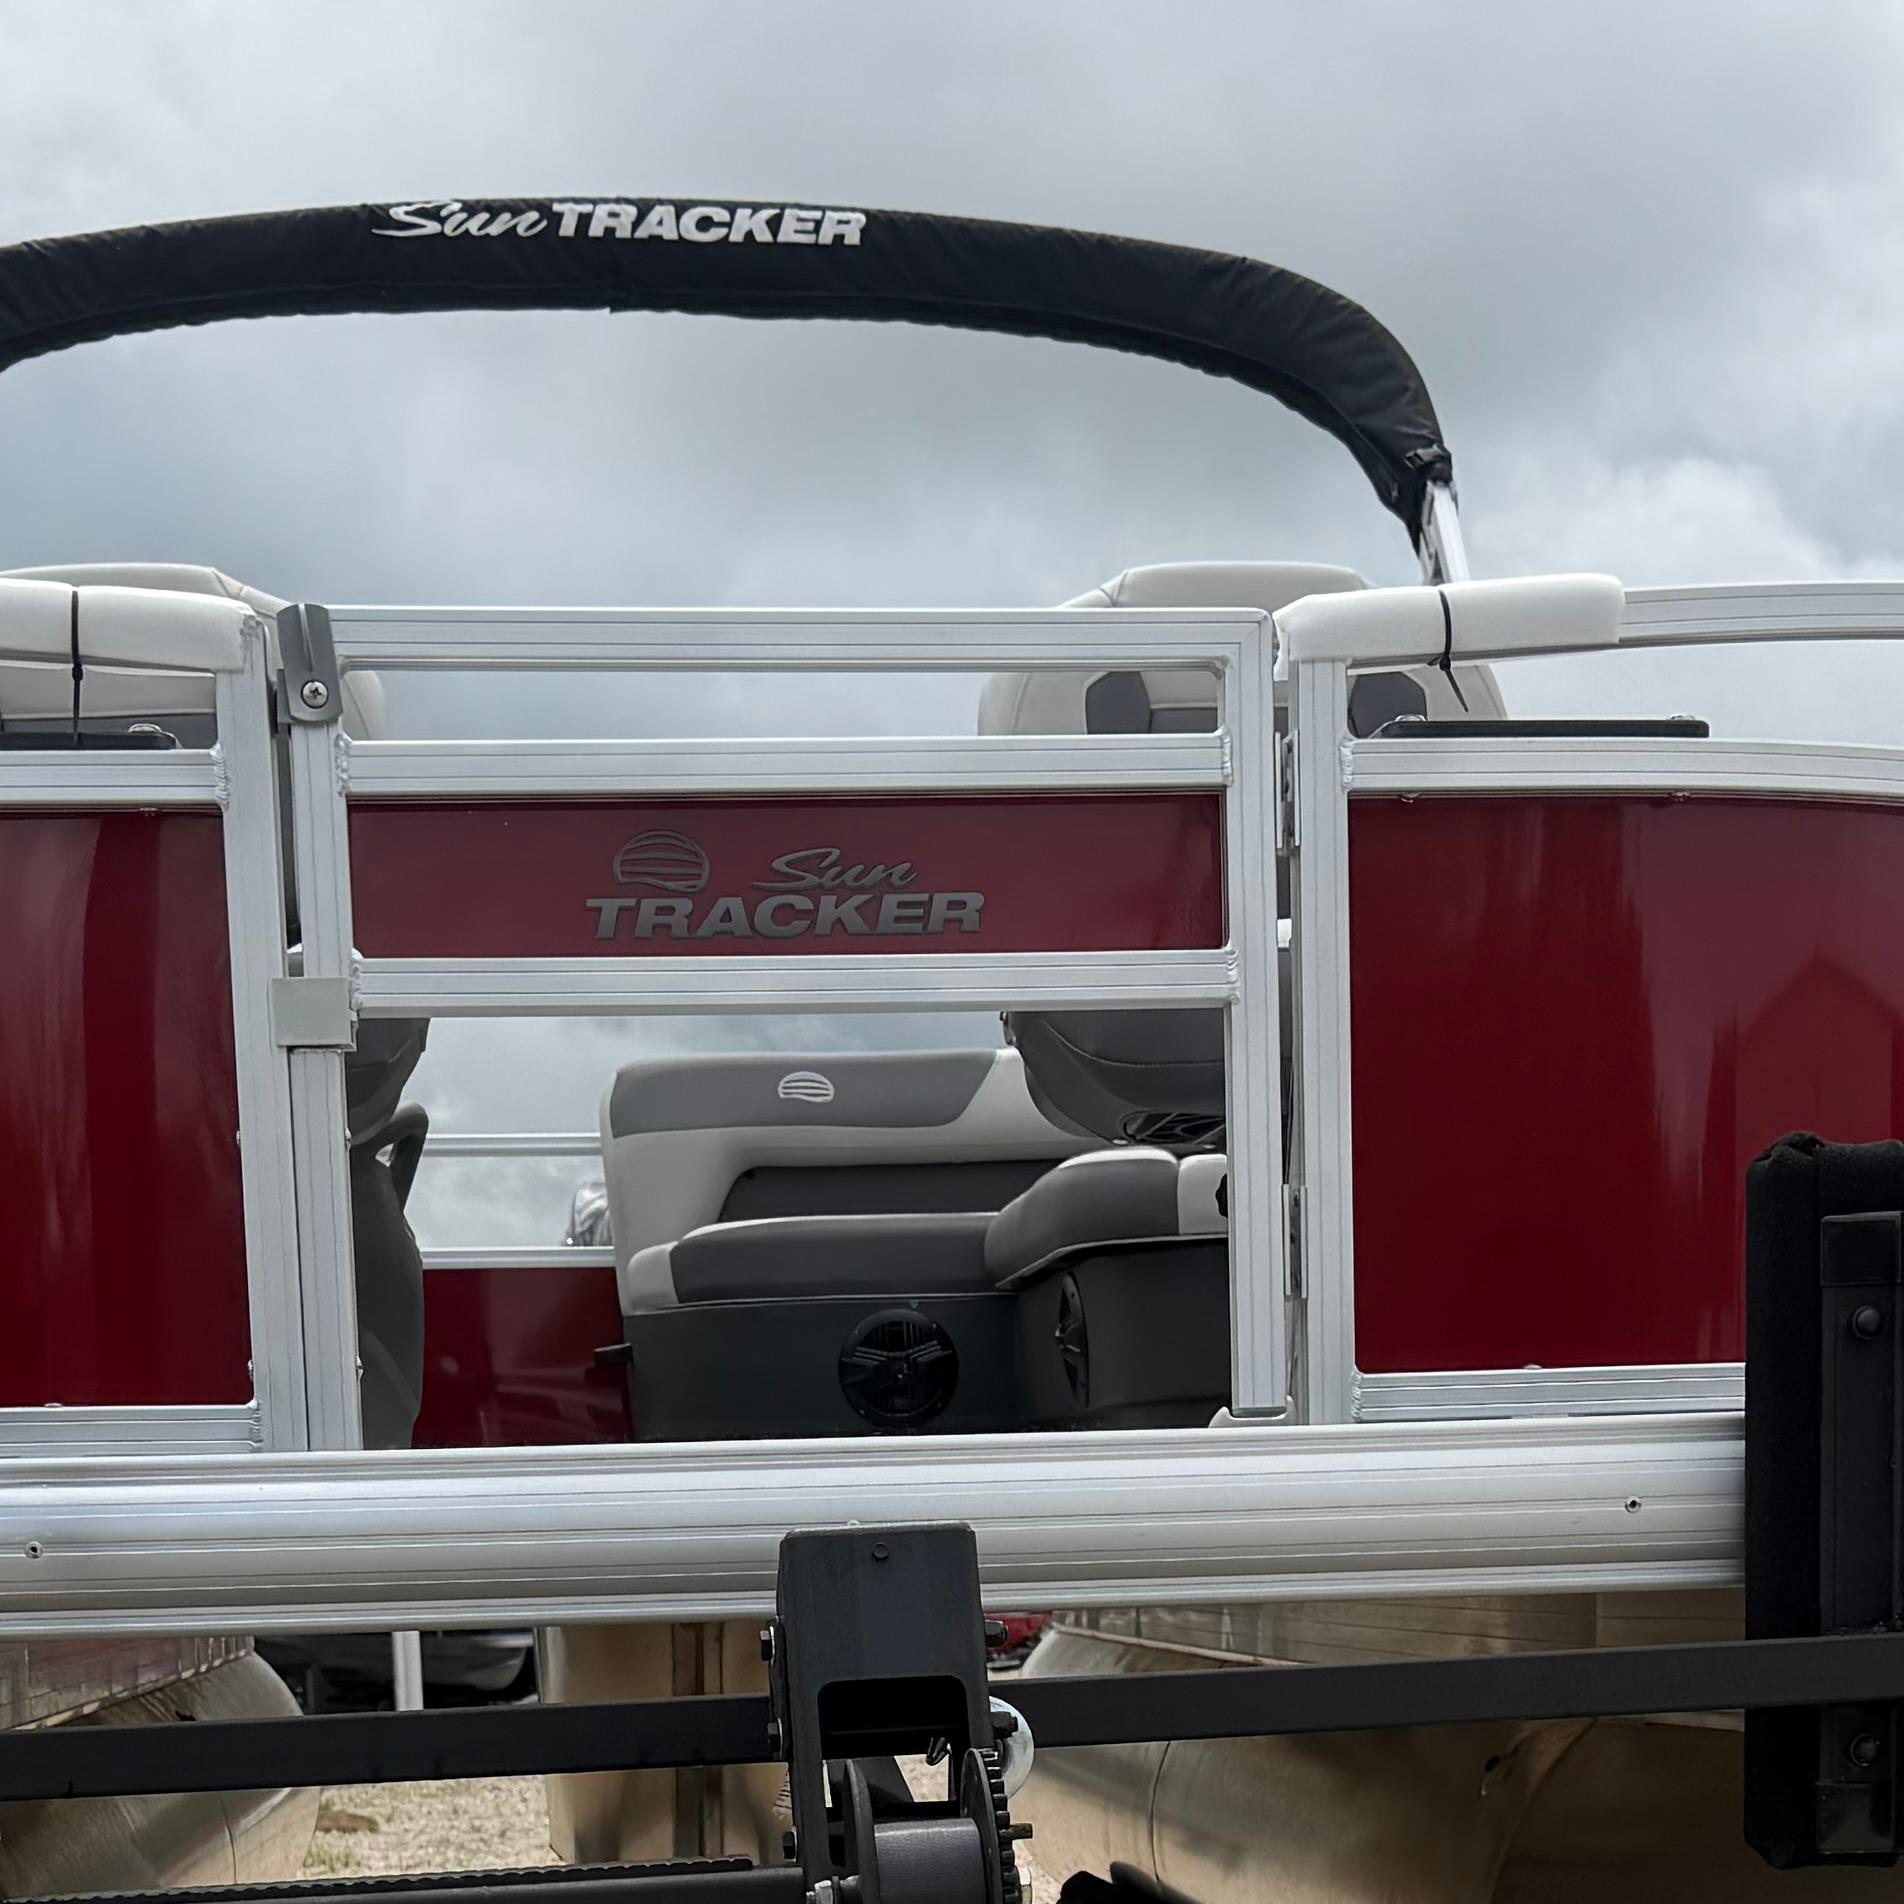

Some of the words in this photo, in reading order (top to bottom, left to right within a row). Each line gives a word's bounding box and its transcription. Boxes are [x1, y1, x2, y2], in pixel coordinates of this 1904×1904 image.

[371, 201, 548, 237] Sun
[552, 202, 867, 246] TRACKER
[752, 847, 919, 890] Sun
[586, 891, 986, 940] TRACKER
